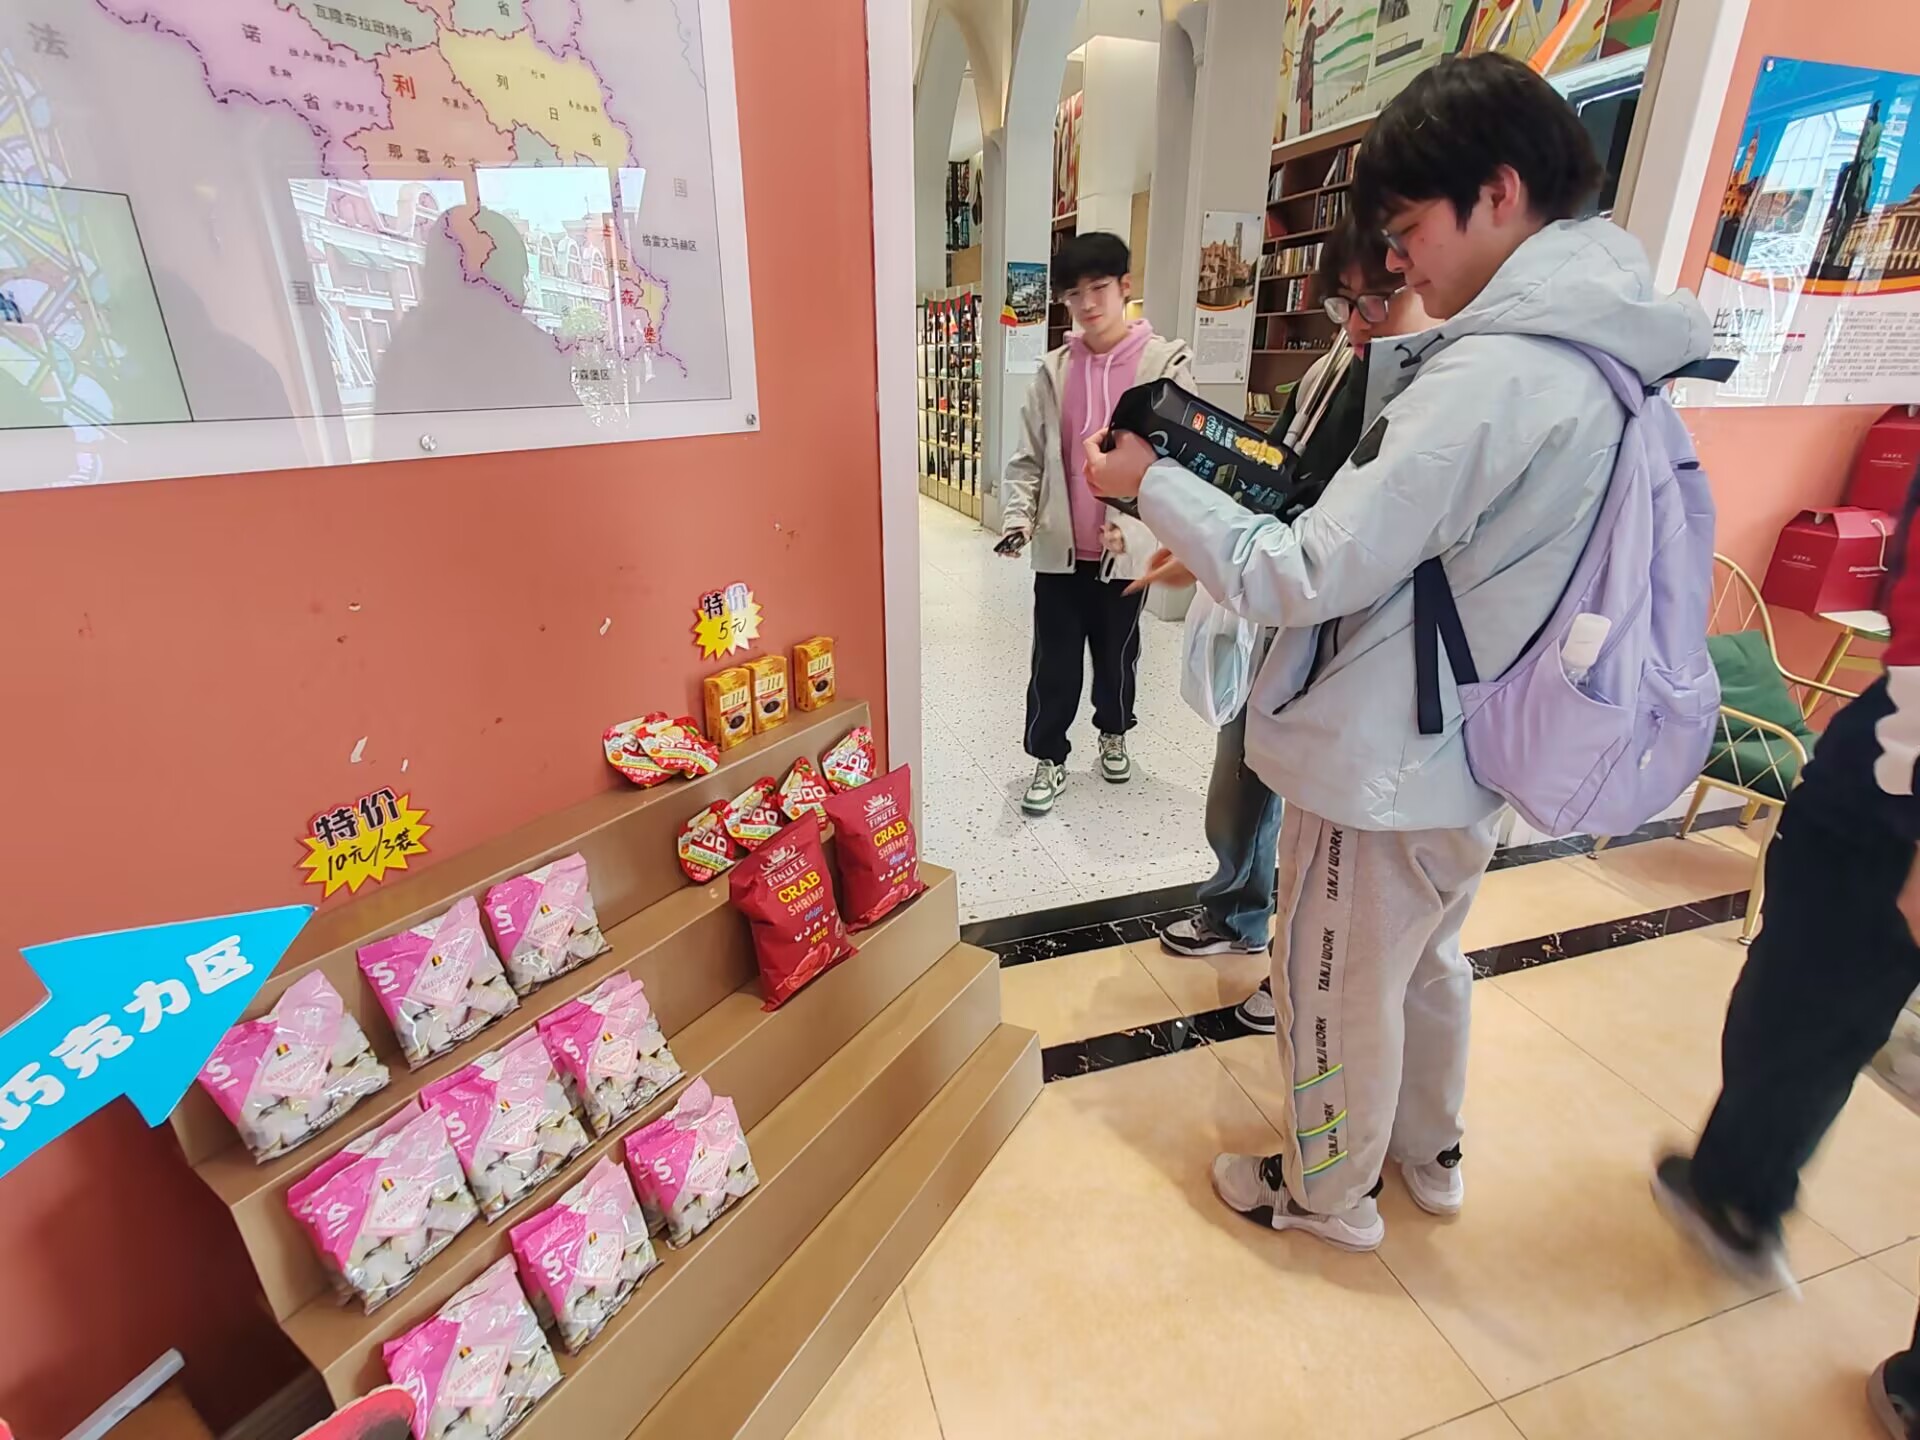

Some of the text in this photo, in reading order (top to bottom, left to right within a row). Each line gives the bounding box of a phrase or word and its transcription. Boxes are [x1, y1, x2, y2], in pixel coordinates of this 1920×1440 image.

[392, 74, 416, 99] 利
[641, 233, 698, 252] 格雷文马赫区
[704, 585, 748, 619] 特价
[718, 617, 747, 640] 5元
[315, 789, 399, 847] 特价
[868, 806, 898, 828] FINUTE
[873, 820, 907, 847] CRAB
[878, 834, 909, 859] SHRIMP
[327, 828, 418, 881] 10元/3袋
[1326, 826, 1344, 902] TANJI WORK
[766, 856, 808, 887] FINUTE
[778, 870, 821, 903] CRAB
[787, 885, 825, 917] SHRIMP
[1317, 927, 1336, 993] TANJI WORK
[0, 934, 254, 1131] 巧克力区
[1315, 1016, 1328, 1048] WORK
